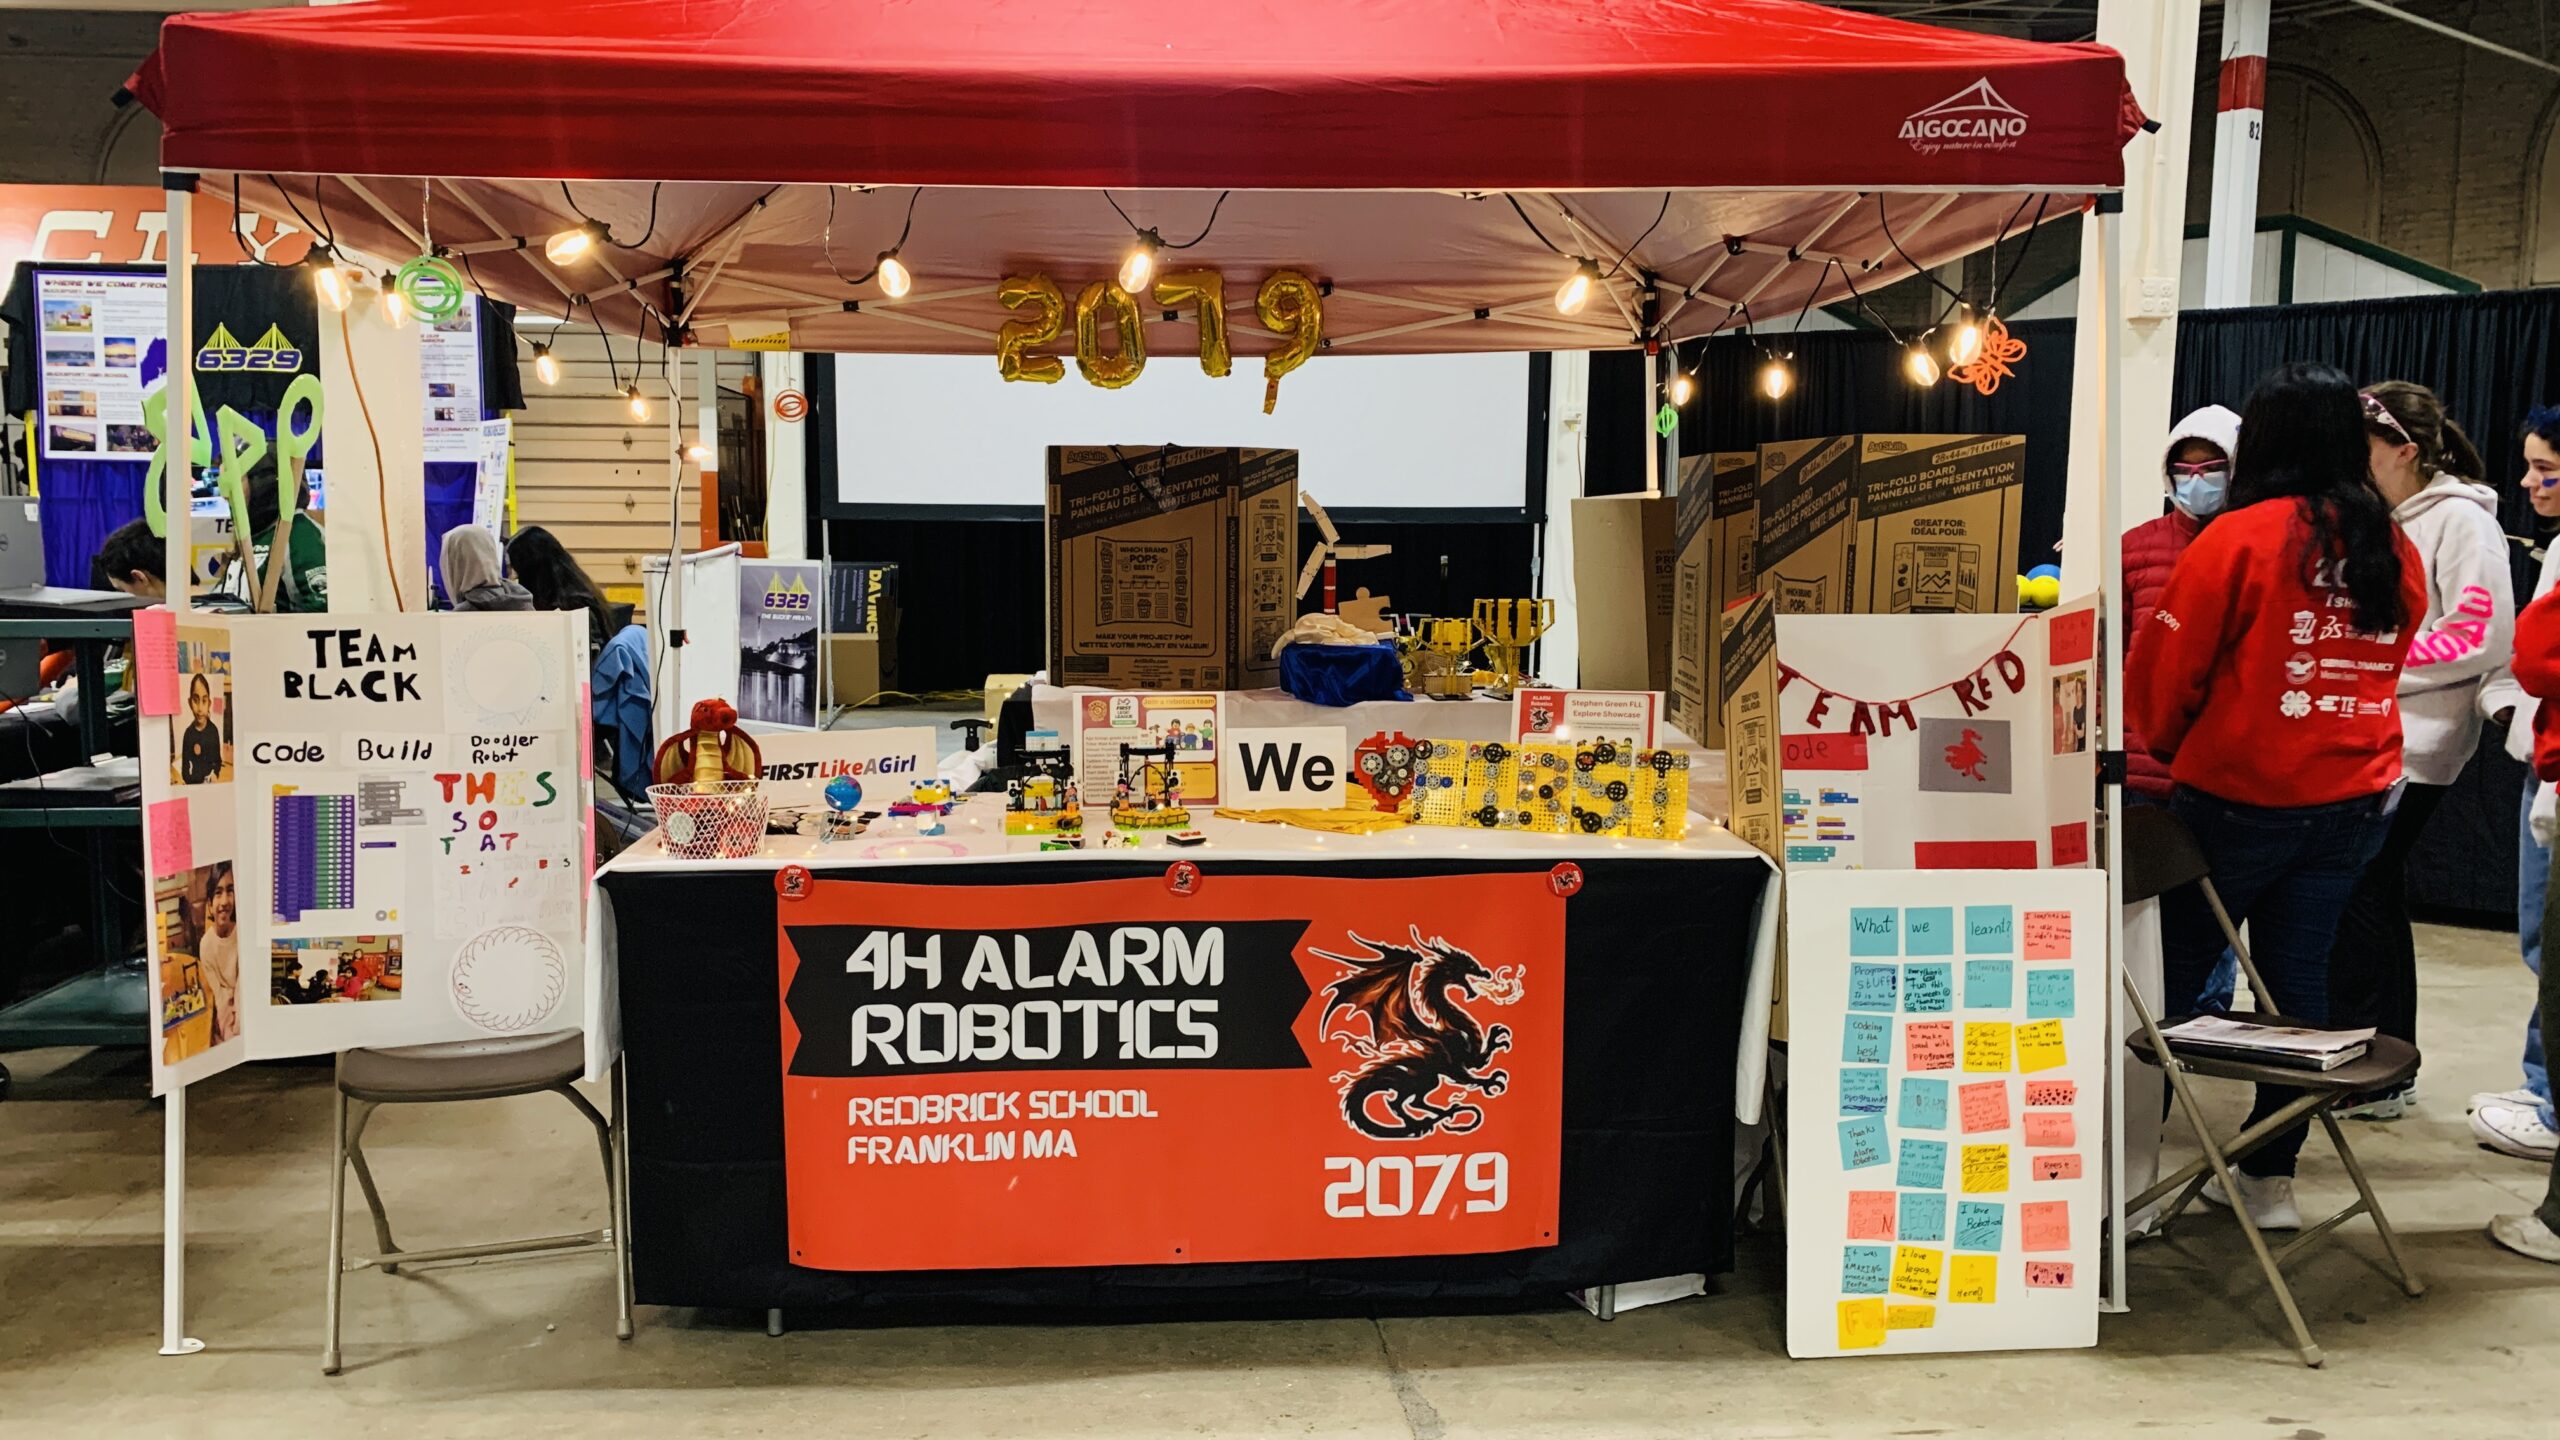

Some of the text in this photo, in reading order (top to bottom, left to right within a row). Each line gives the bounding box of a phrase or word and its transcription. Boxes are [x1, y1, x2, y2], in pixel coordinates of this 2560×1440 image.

[1898, 118, 2027, 142] AIGOCANO
[2249, 120, 2261, 142] 82
[1910, 138, 1941, 155] Enjoy
[998, 270, 1323, 392] 2079
[198, 349, 302, 370] 6329
[1868, 465, 1956, 493] TRI-FOLD BOARD
[1868, 486, 1917, 503] PANNEAU
[1919, 481, 1932, 490] DE
[1070, 497, 1120, 519] PANNEAU
[1122, 494, 1137, 507] DE
[1911, 527, 1967, 536] IDÉAL POUR:
[1913, 519, 1966, 527] GREAT FOR:
[1129, 555, 1158, 563] POPS
[763, 592, 811, 610] 6329
[307, 628, 418, 669] TEAM
[283, 670, 422, 702] BLACK
[1952, 650, 2026, 718] RED
[1572, 700, 1603, 710] Stephen
[1605, 700, 1628, 708] Green
[1777, 659, 1917, 737] TEAM
[1573, 709, 1641, 719] Explore Showcase
[252, 741, 325, 764] Code
[358, 738, 432, 761] Build
[471, 735, 539, 747] Doodler
[472, 748, 519, 764] Robot
[1239, 742, 1335, 792] We
[1854, 915, 1893, 934] What
[1912, 921, 1930, 933] we
[846, 926, 1224, 991] 4H ALARM
[851, 999, 1218, 1067] ROBOTICS
[848, 1089, 1158, 1127] REDBRICK SCHOOL
[848, 1128, 1078, 1165] FRANKLIN MA
[1324, 1152, 1509, 1218] 2079
[1960, 1204, 1969, 1215] I
[1901, 1248, 1927, 1260] I love
